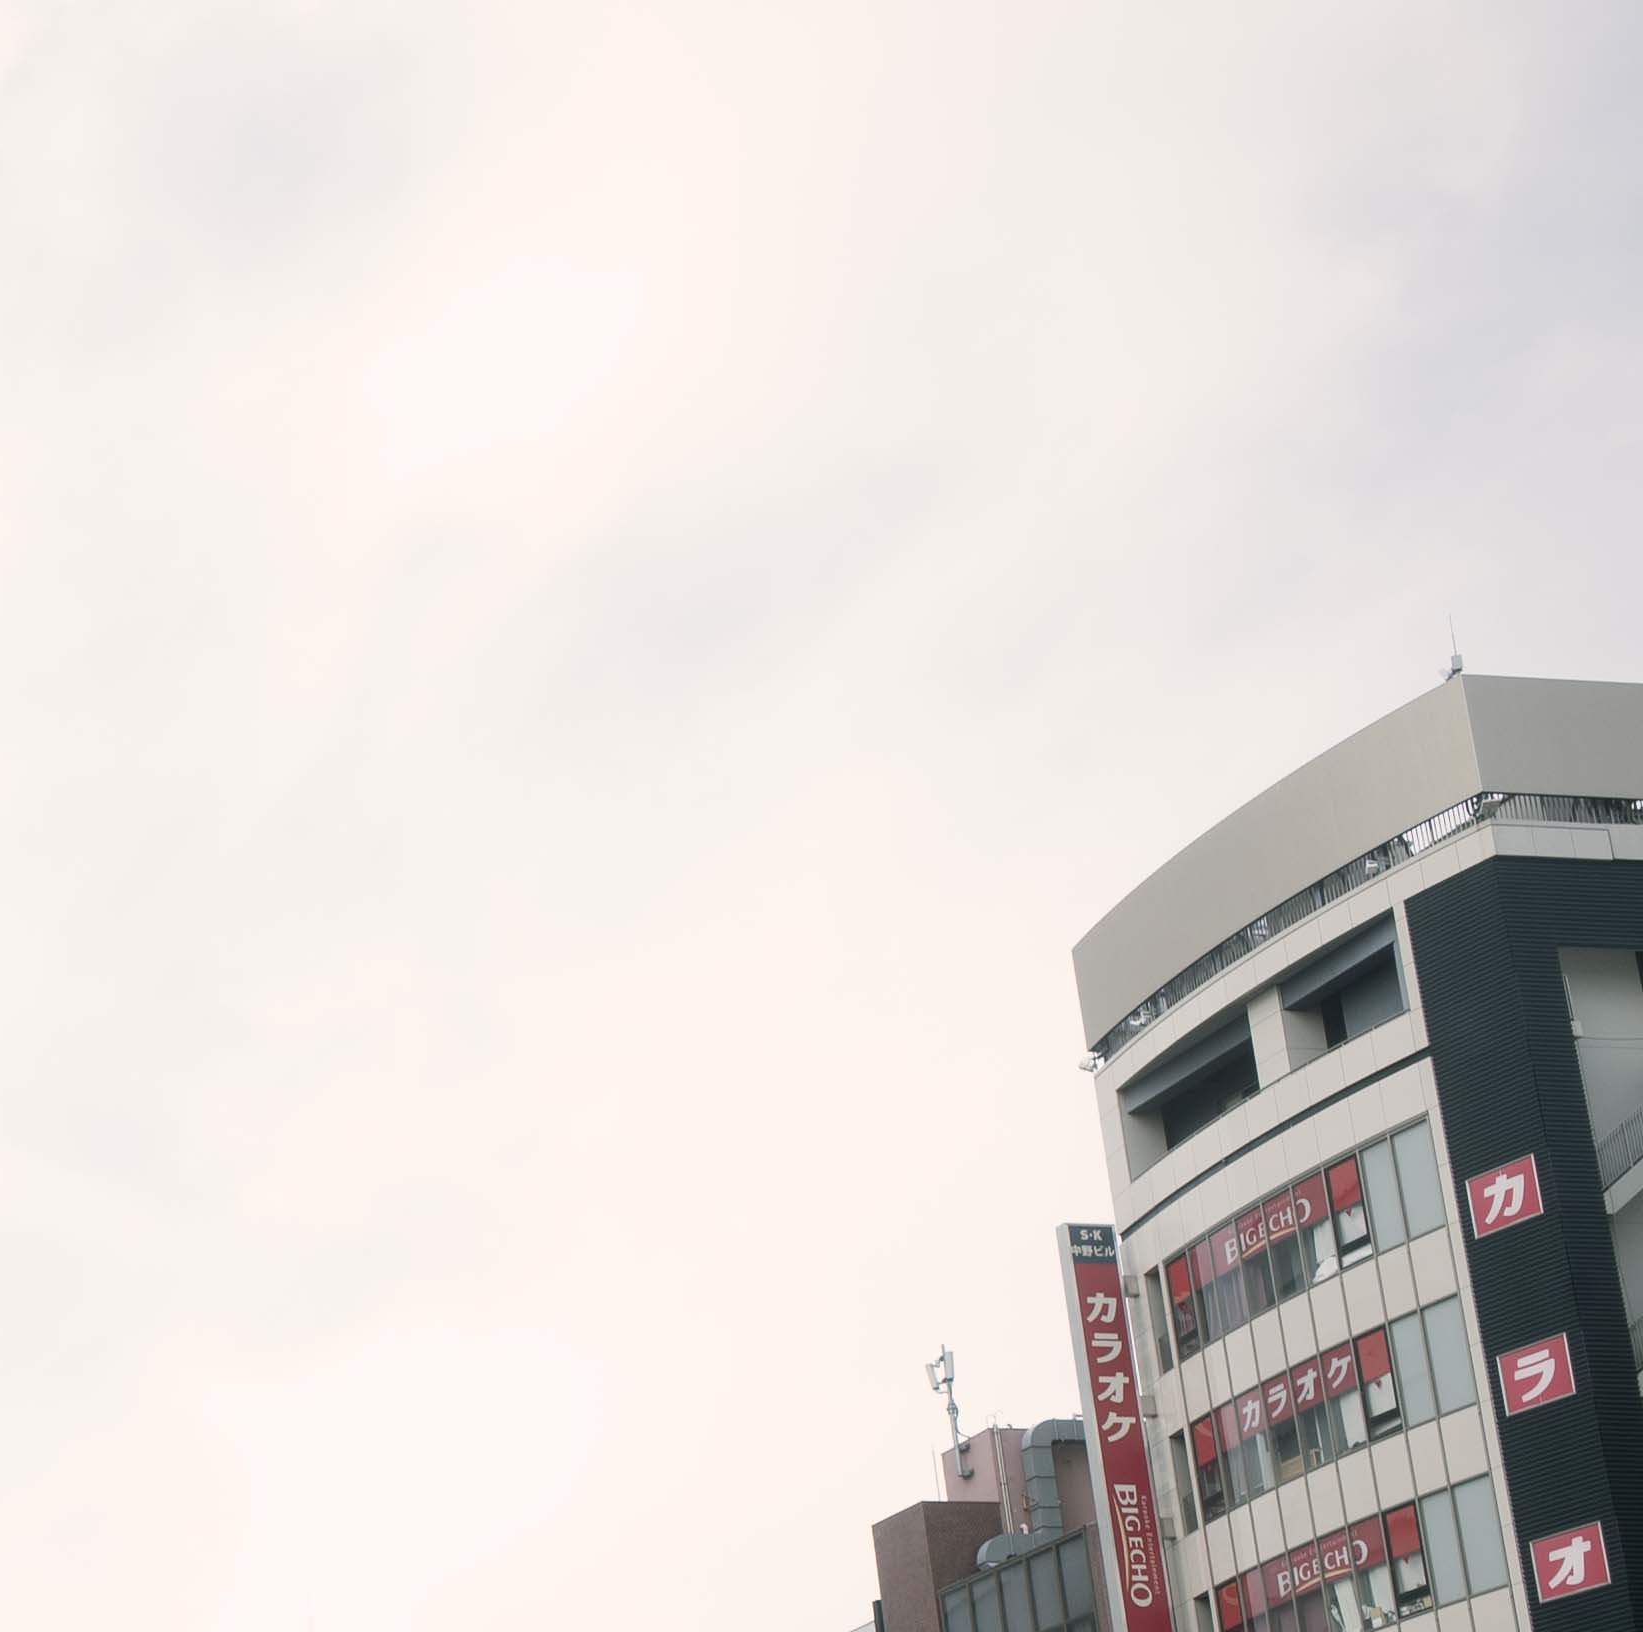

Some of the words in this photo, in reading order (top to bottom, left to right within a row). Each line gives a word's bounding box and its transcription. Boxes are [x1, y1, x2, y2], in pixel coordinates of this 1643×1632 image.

[1070, 1243, 1116, 1258] 中野ビル
[1086, 1292, 1137, 1444] カラオケ
[1242, 1352, 1356, 1434] カラオケ
[1113, 1483, 1142, 1533] BIG
[1127, 1536, 1154, 1608] ECHO
